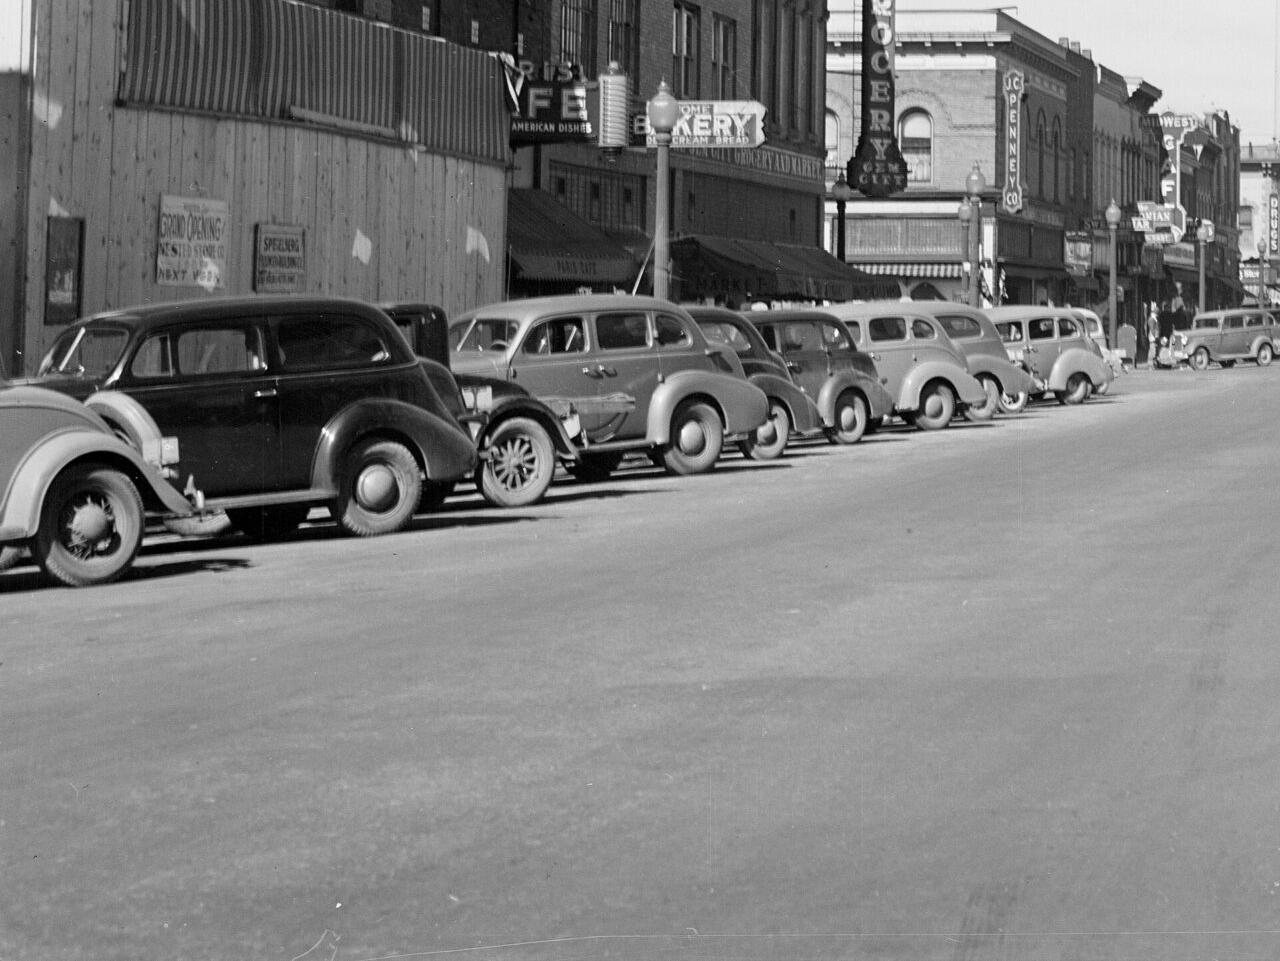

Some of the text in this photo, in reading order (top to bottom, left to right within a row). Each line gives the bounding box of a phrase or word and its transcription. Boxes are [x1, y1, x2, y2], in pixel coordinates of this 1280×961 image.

[679, 105, 713, 115] OME
[511, 121, 592, 134] AMERICAN DISHES
[634, 112, 754, 137] BKERY
[1140, 116, 1199, 128] MIDWEST
[673, 136, 750, 145] CREAM BREAD
[1009, 93, 1017, 188] PENNEY
[734, 147, 775, 171] GROCERY
[859, 173, 905, 186] CITY
[159, 213, 186, 240] GRAND
[1270, 197, 1278, 251] DRUGS
[159, 268, 188, 281] NEXT
